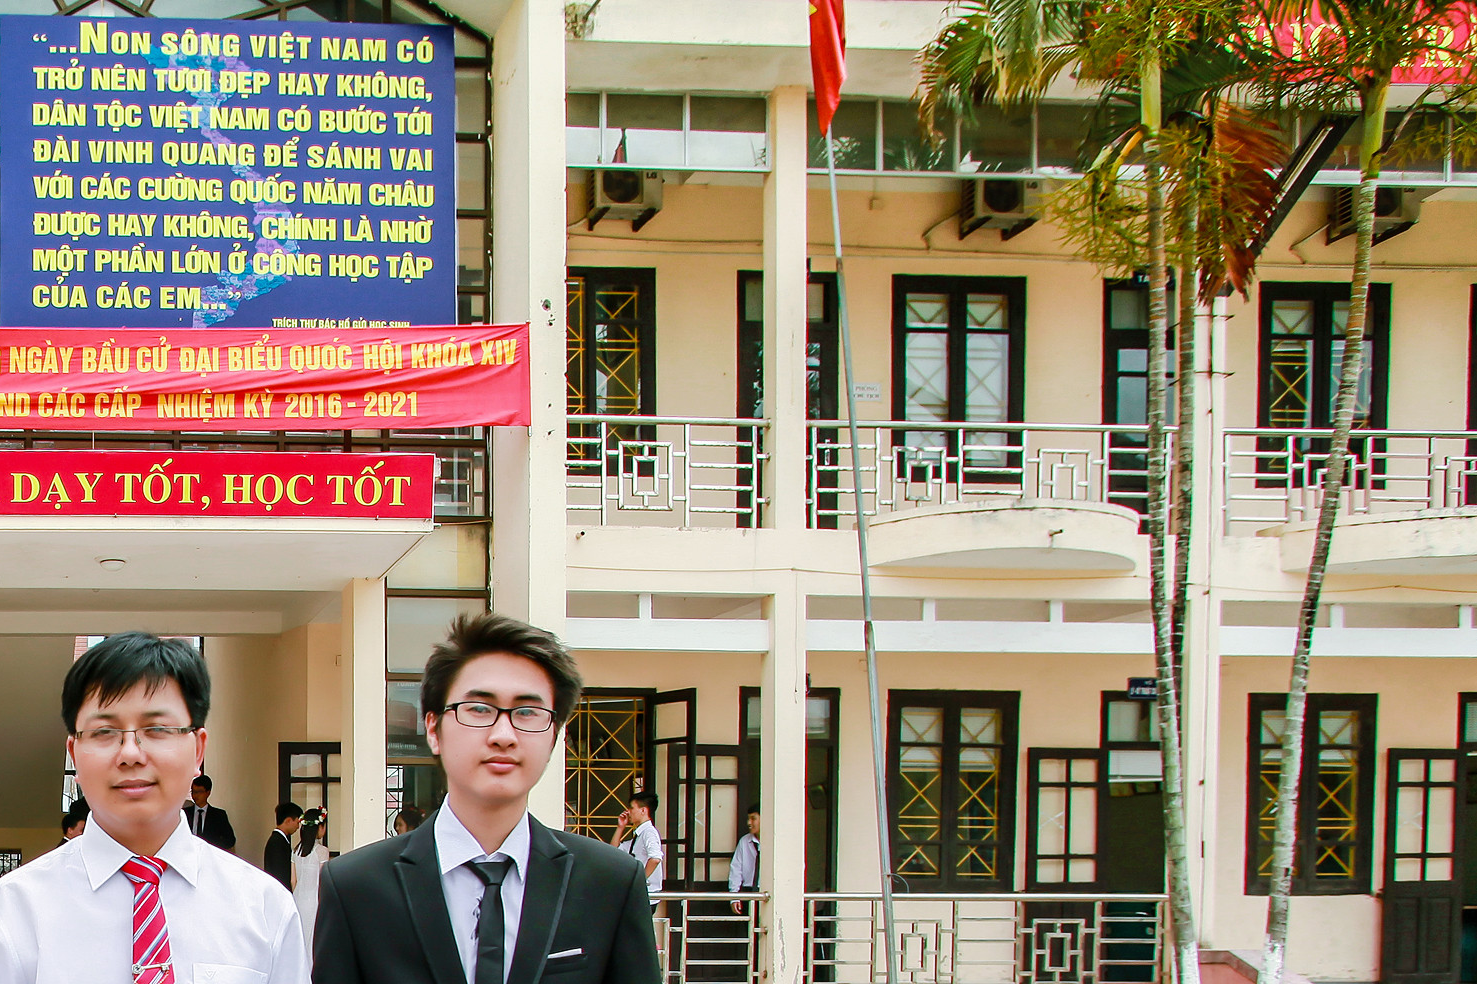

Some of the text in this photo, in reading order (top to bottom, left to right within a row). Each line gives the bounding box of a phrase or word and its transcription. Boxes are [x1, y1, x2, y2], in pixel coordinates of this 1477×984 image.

[161, 28, 240, 57] SÔNG
[249, 31, 312, 64] VIỆT
[320, 36, 387, 62] NAM
[396, 36, 434, 64] CÓ
[33, 58, 433, 103] TRỞ NÊN TƯƠI ĐẸP HAY KHÔNG,
[32, 98, 433, 136] DÂN TỘC VIỆT NAM CÓ BƯỚC TỚI
[33, 135, 433, 172] ĐÀI VINH QUANG ĐỂ SÁNH VAI
[33, 169, 435, 208] VỚI CÁC CƯỜNG QUỐC NĂM CHÂU
[33, 210, 434, 244] ĐƯỢC HAY KHÔNG, CHÍNH LÀ NHỜ
[32, 242, 434, 284] MỘT PHẦN LỚN Ở CÔNG HỌC TẬP
[32, 276, 88, 309] CỦA
[96, 282, 151, 309] CÁC
[272, 317, 298, 328] TRÍCH
[300, 319, 318, 328] THƯ
[319, 318, 336, 329] BÁC
[9, 339, 73, 374] NGÀY
[82, 338, 130, 373] BẦU
[136, 336, 172, 373] CỬ
[179, 346, 219, 378] ĐẠI
[229, 334, 282, 372] BIỂU
[363, 339, 403, 374] HỘI
[411, 336, 473, 369] KHÓA
[480, 339, 517, 365] XIV
[38, 387, 86, 418] CÁC
[94, 385, 141, 418] CẤP
[157, 388, 235, 422] NHIỆM
[244, 388, 274, 419] KỲ
[285, 393, 341, 418] 2016
[364, 391, 418, 417] 2021
[11, 472, 104, 512] DẠY
[114, 459, 212, 511] TỐT,
[222, 473, 314, 512] HỌC
[326, 460, 412, 507] TỐT
